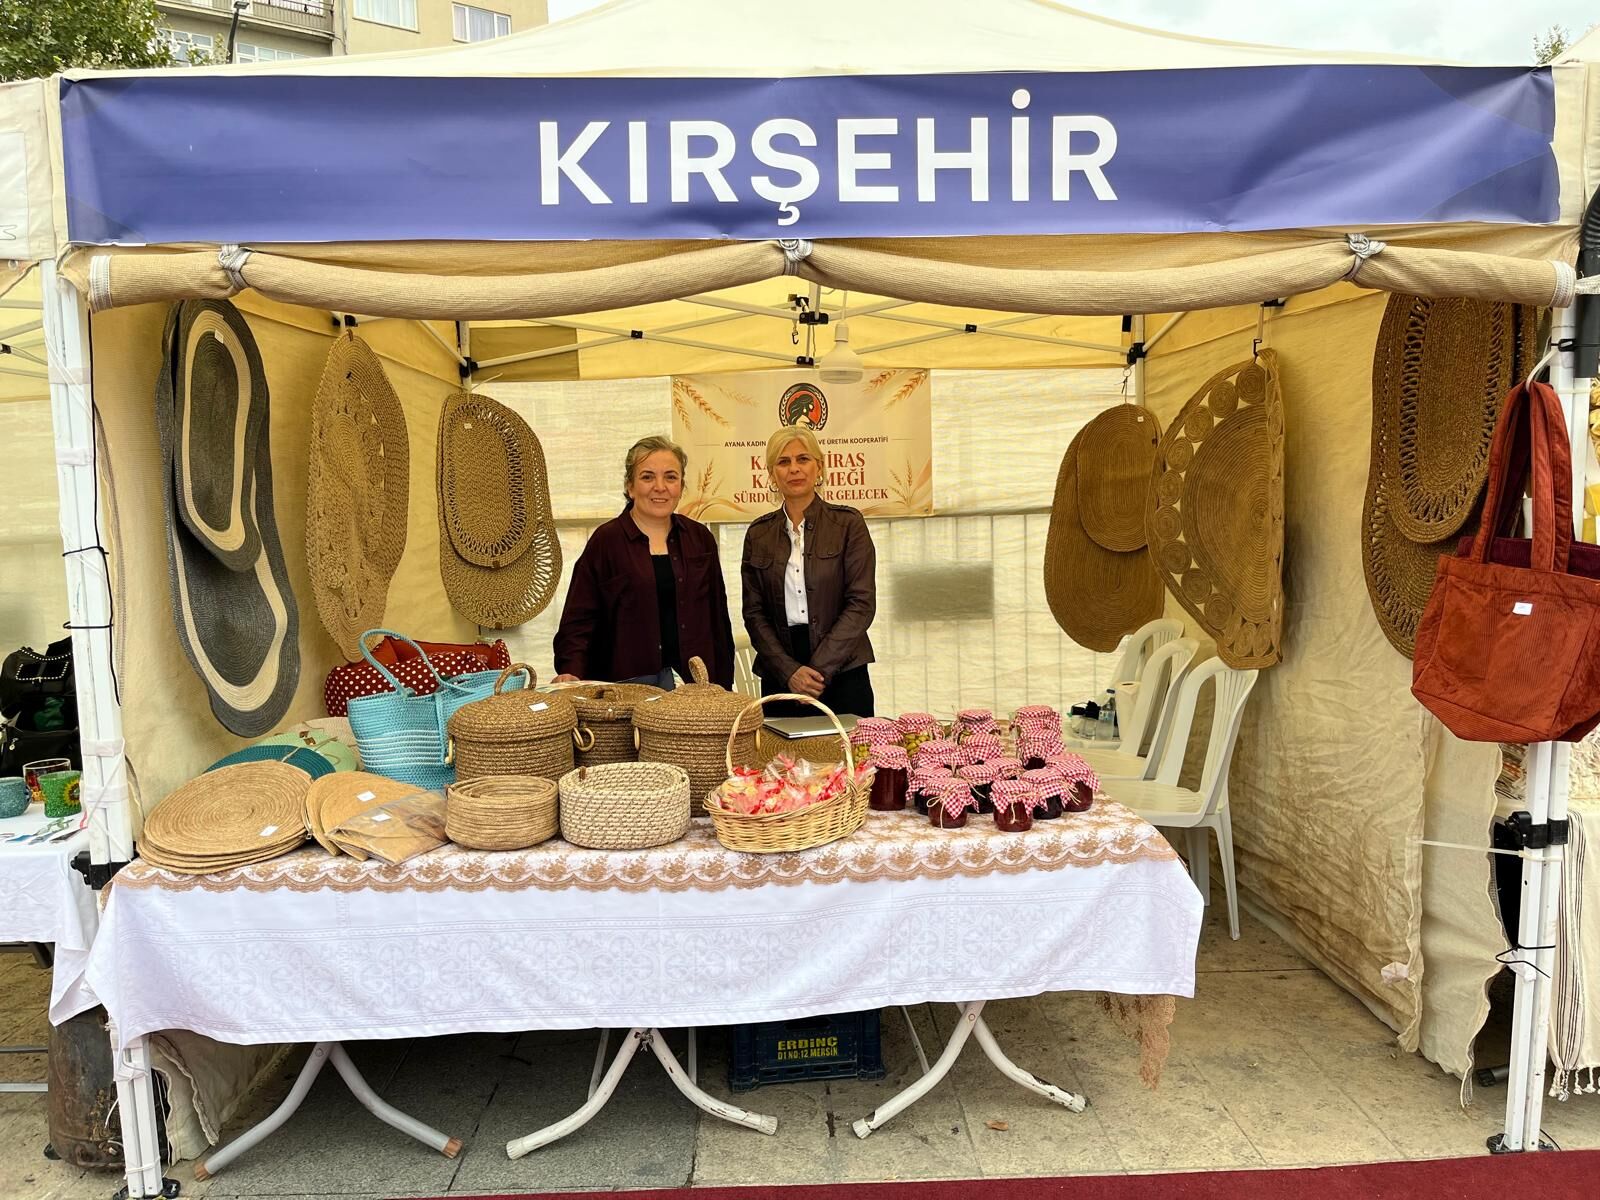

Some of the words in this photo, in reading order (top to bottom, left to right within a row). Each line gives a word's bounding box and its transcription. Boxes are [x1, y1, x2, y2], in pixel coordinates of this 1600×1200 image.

[539, 89, 1119, 226] KIRŞEHİR
[823, 450, 865, 468] İRAS
[826, 467, 865, 486] MEĞİ
[836, 488, 889, 501] GELECEK
